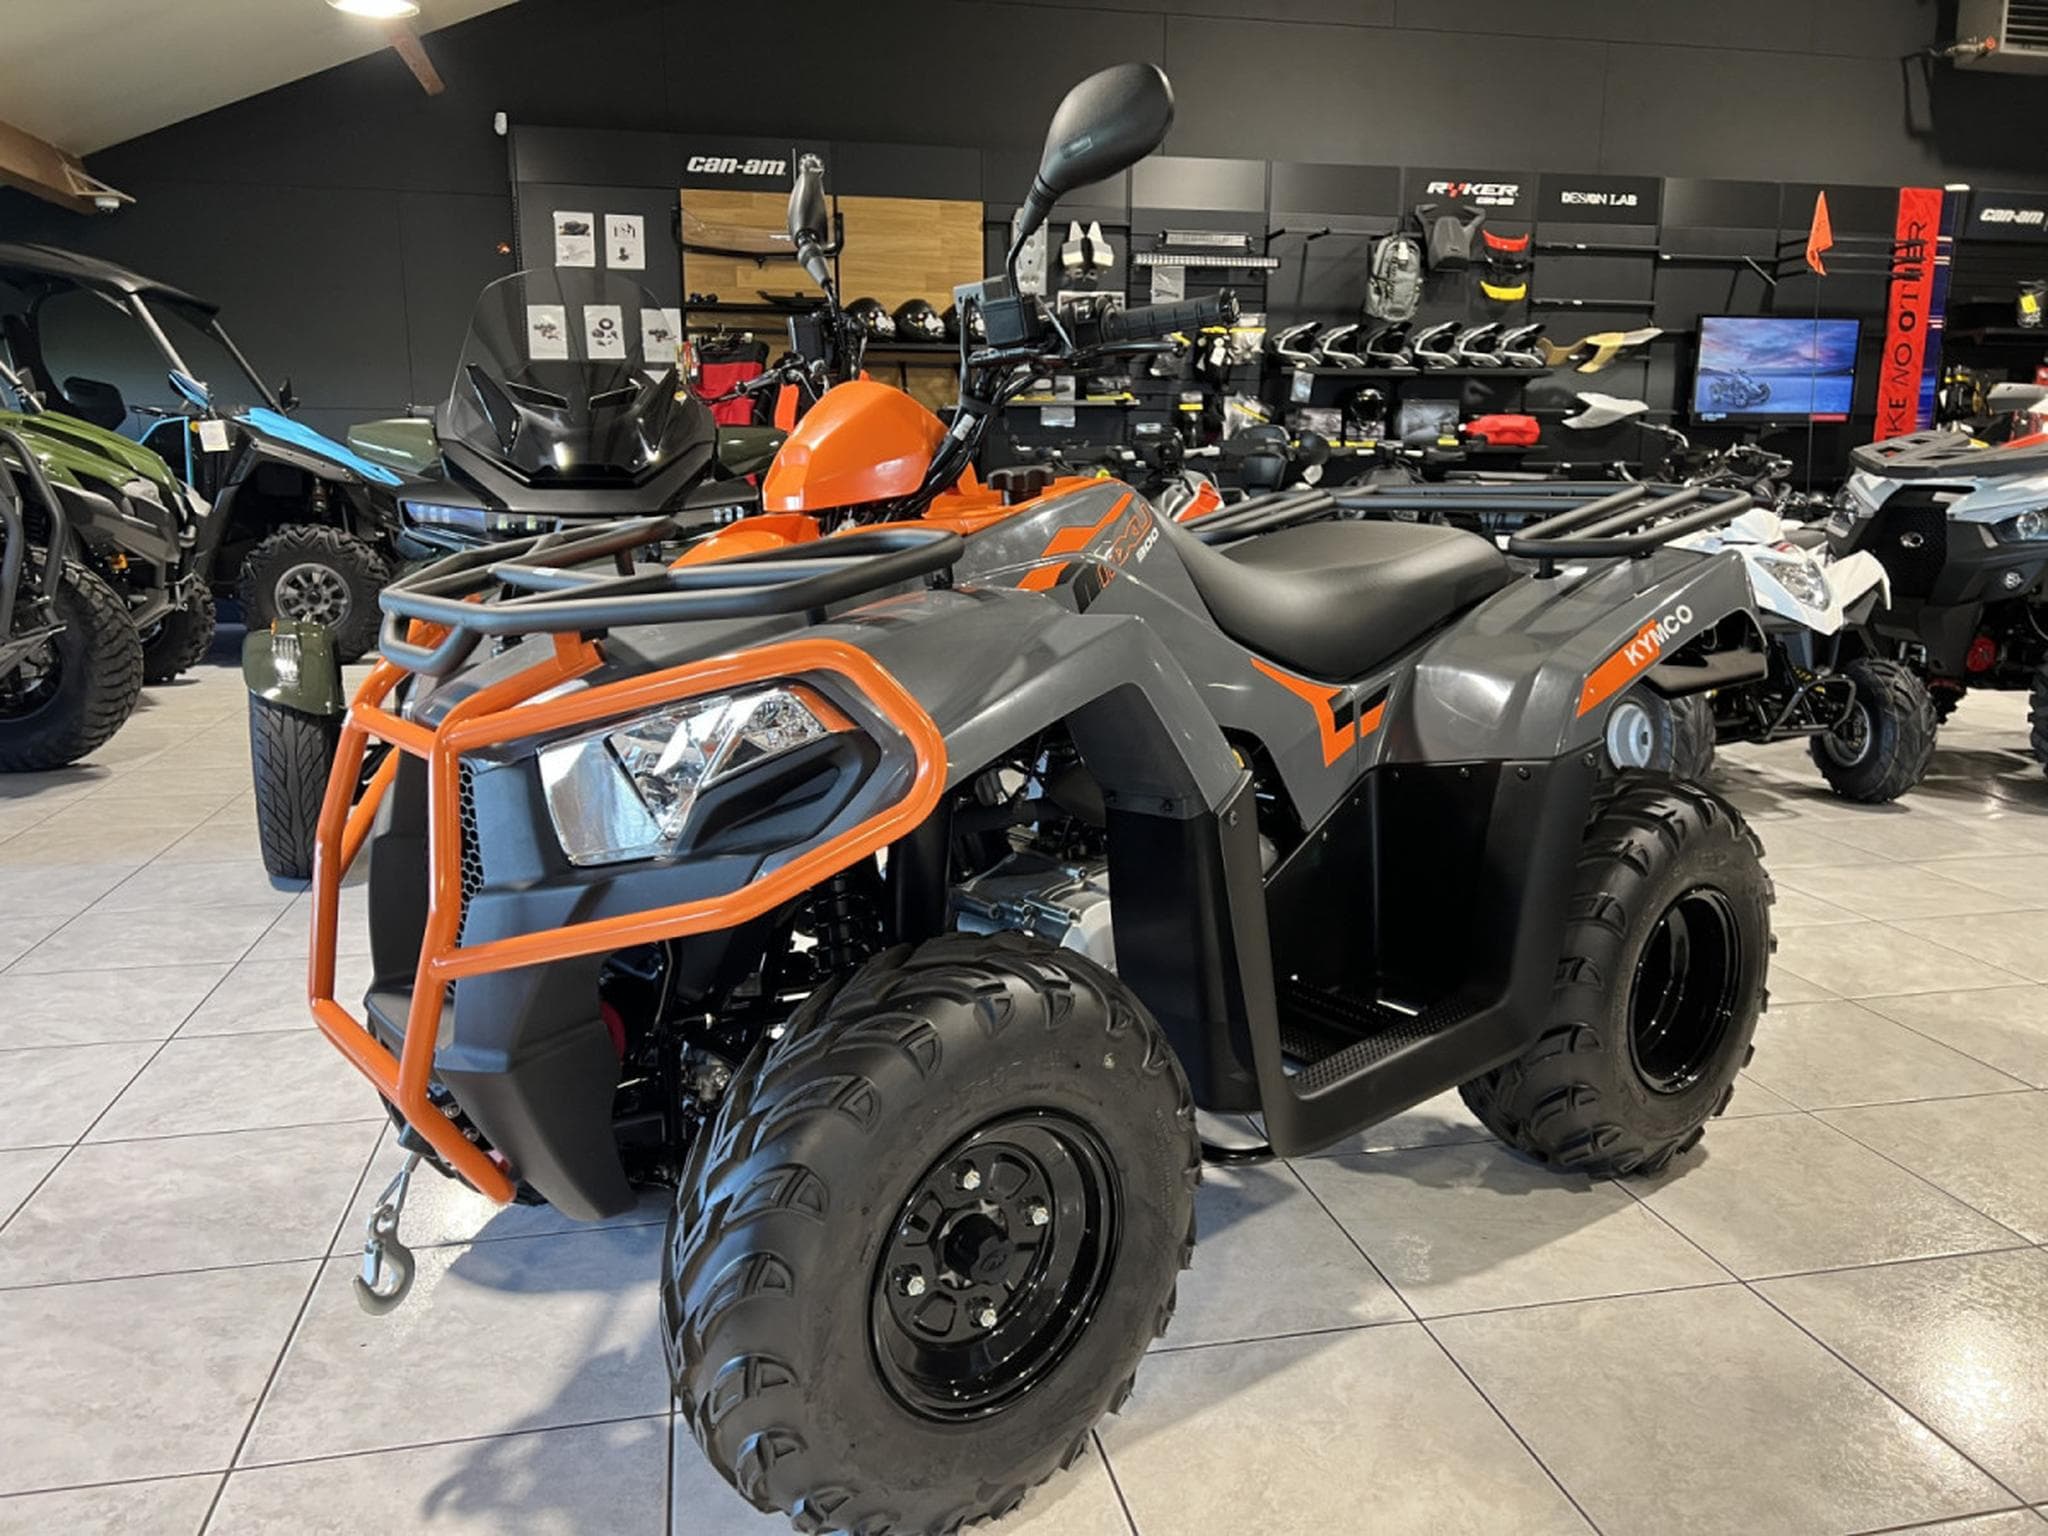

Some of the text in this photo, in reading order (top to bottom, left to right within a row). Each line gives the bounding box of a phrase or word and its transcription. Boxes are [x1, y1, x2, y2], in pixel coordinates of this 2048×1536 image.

[687, 156, 785, 175] can-am
[1427, 182, 1519, 198] RYKER
[1561, 192, 1638, 206] DESIGN LAB
[1891, 342, 1912, 386] NO
[1624, 604, 1693, 667] KYMCO
